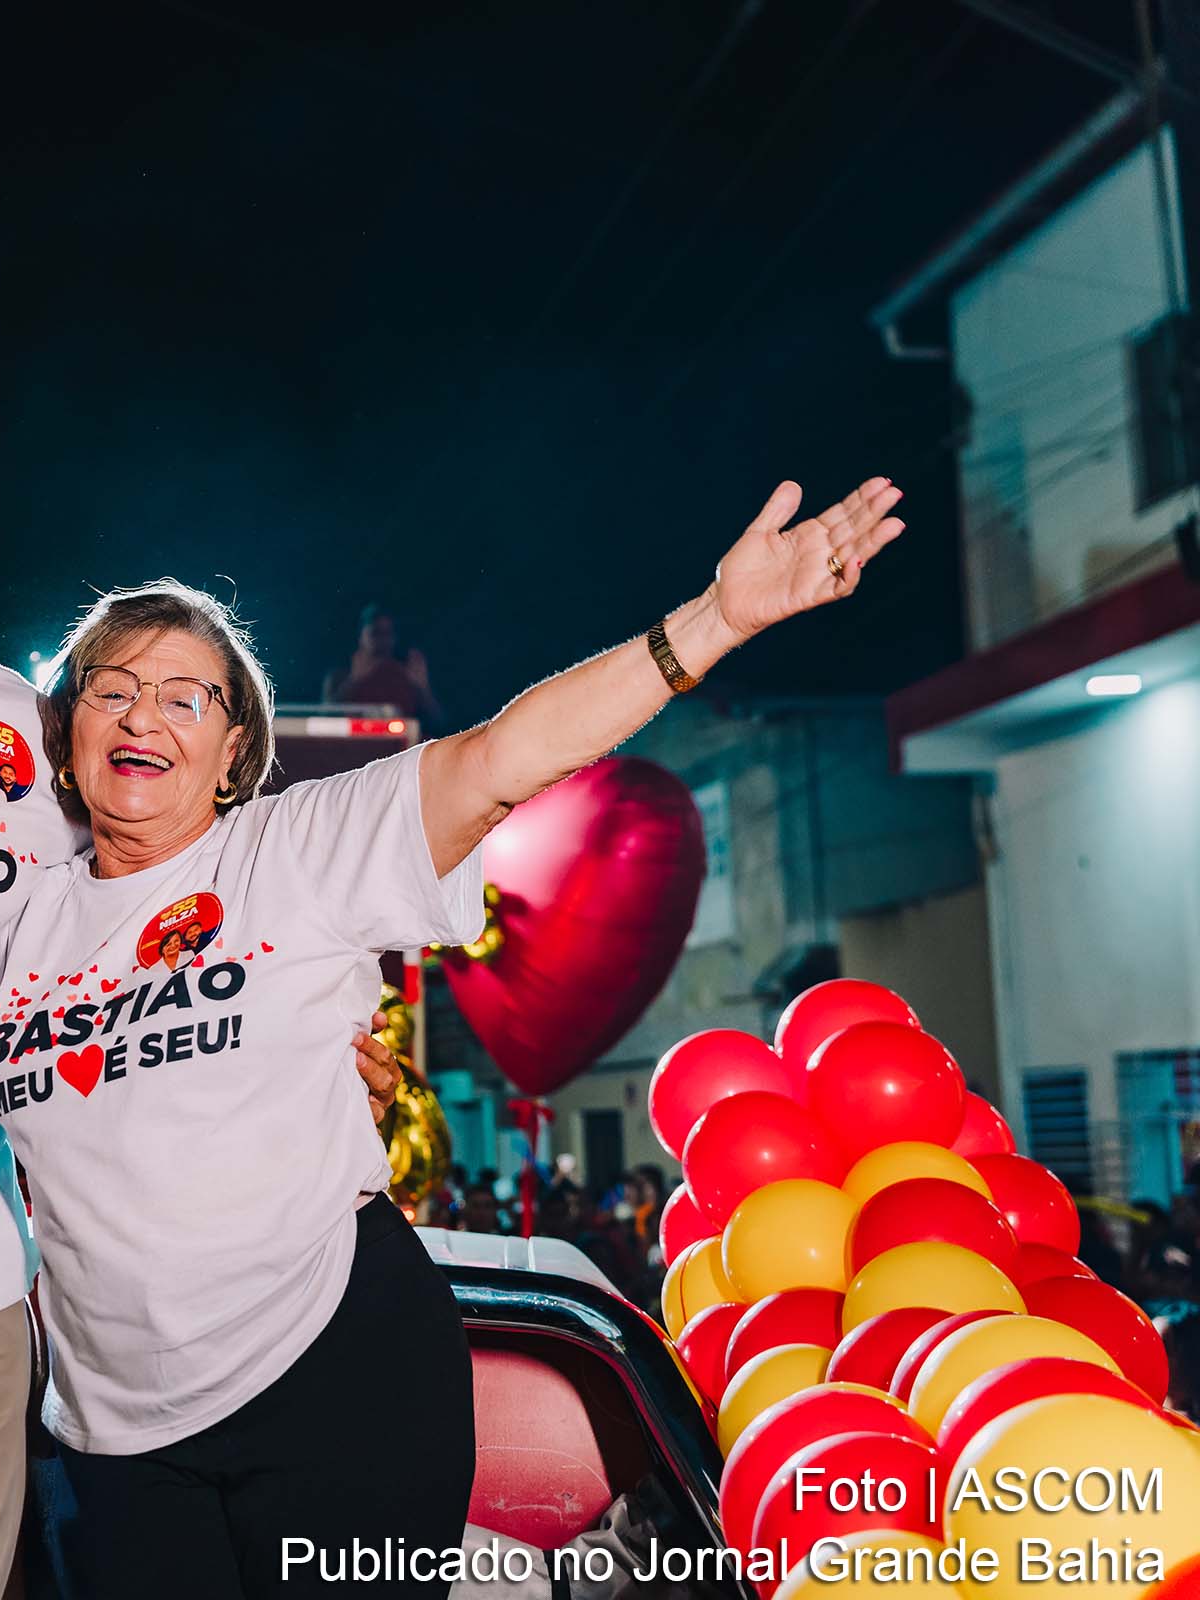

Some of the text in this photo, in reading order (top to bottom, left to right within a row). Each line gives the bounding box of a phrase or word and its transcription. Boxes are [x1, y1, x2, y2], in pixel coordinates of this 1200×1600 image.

[171, 895, 198, 916] 55
[160, 907, 198, 931] NILZA
[104, 1035, 127, 1082] É
[138, 1014, 242, 1068] SEU!
